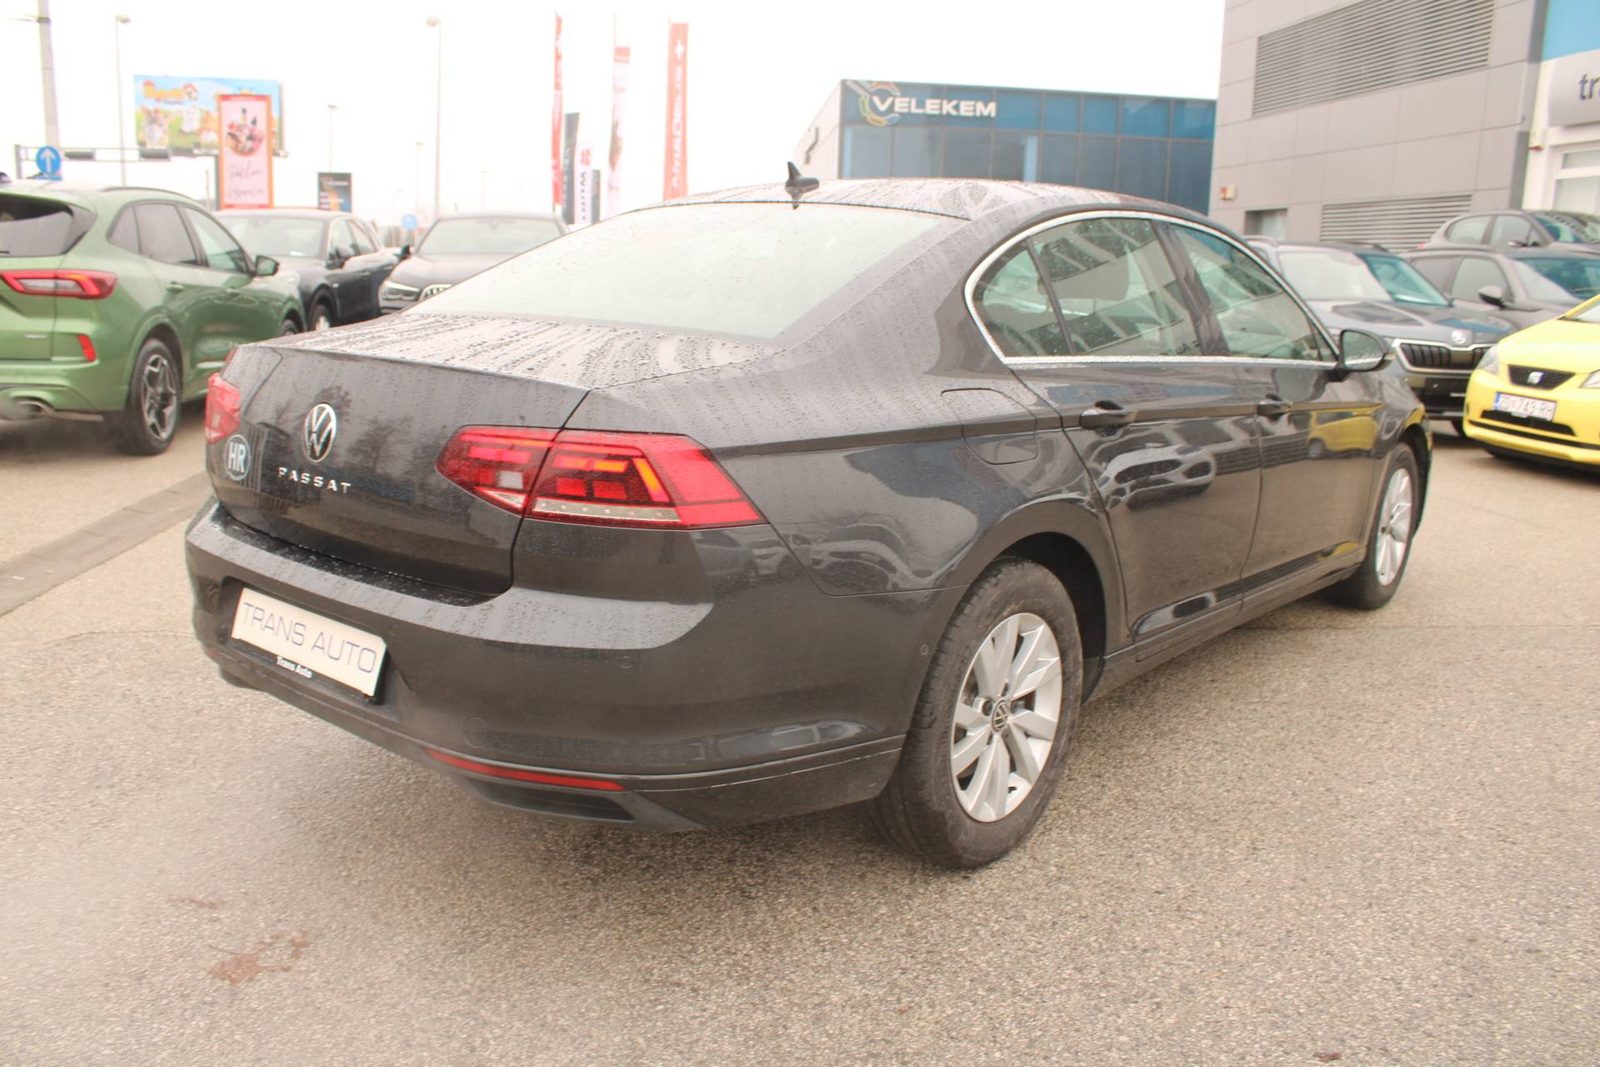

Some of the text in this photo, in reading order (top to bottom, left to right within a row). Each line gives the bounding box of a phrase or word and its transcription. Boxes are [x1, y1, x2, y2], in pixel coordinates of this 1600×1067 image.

[1579, 73, 1600, 100] tr
[871, 94, 997, 118] VELEKEM
[228, 441, 246, 473] HR
[277, 466, 351, 494] PASSAT
[243, 602, 377, 674] TRANS AUTO
